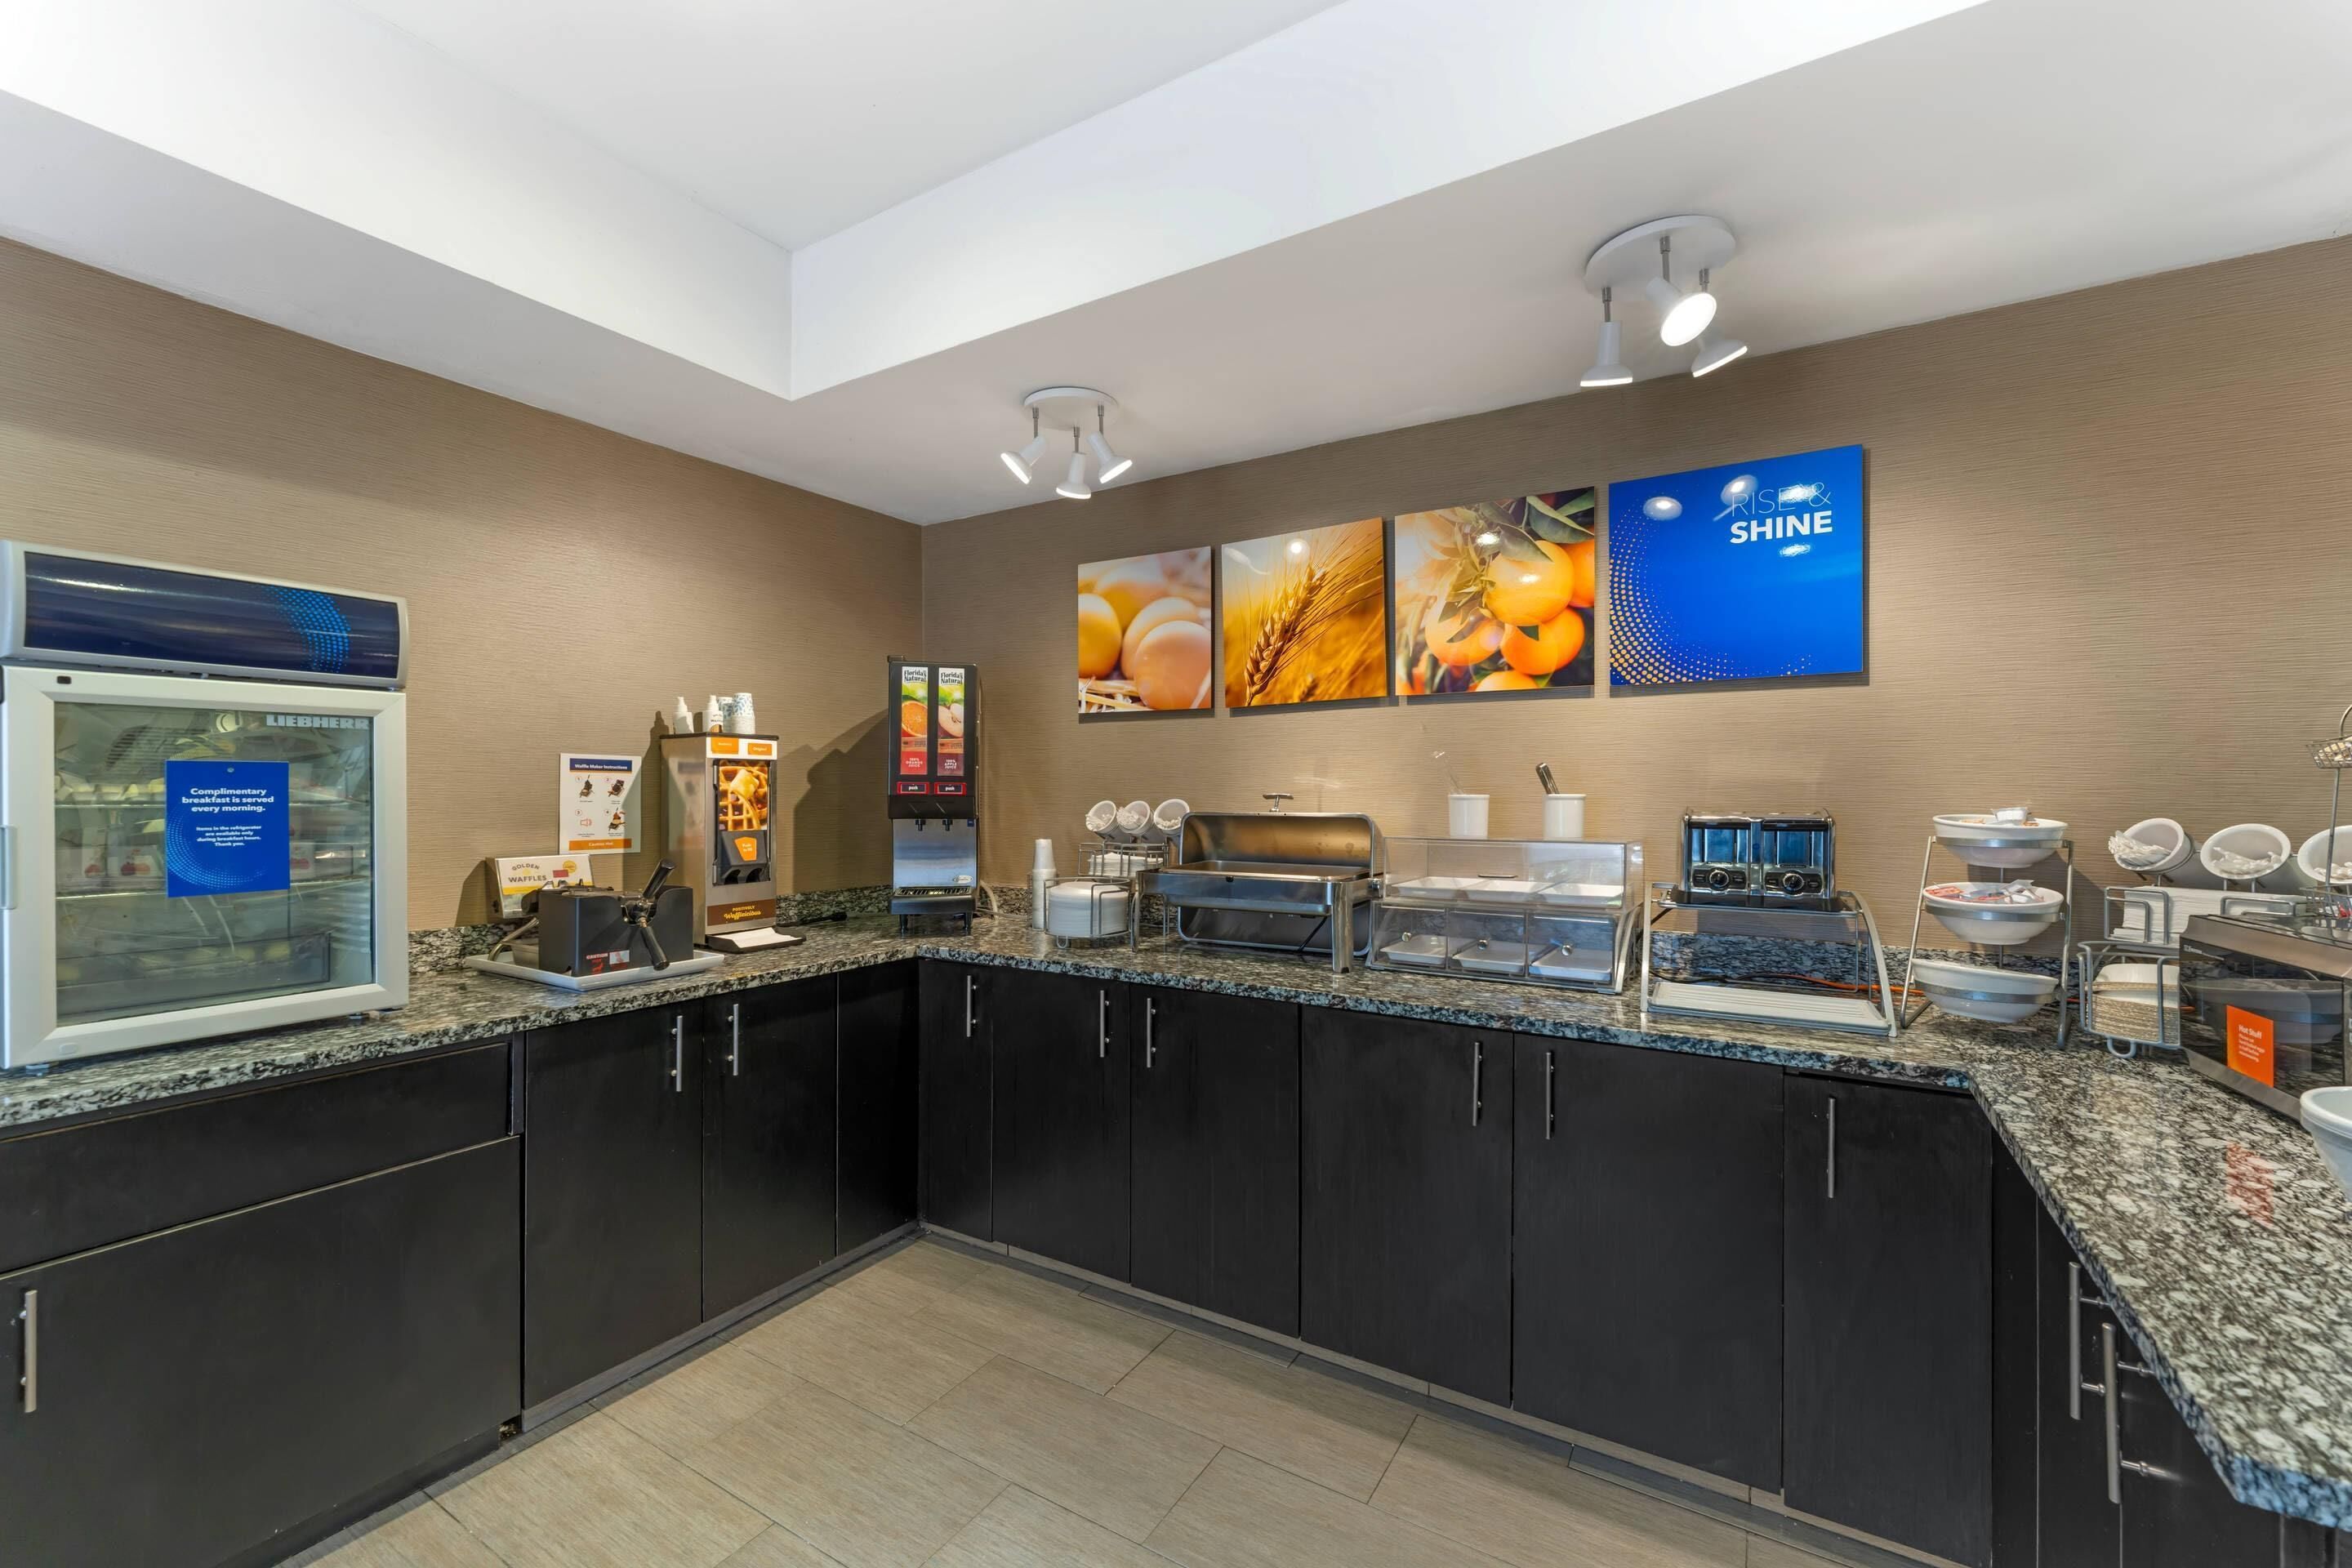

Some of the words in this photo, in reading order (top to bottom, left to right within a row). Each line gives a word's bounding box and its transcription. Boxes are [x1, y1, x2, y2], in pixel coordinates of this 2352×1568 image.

[1731, 488, 1797, 517] RISE
[1808, 482, 1832, 507] &
[1730, 510, 1833, 544] SHINE
[904, 670, 927, 678] Florida's
[266, 714, 369, 729] LIEBHERR
[190, 788, 267, 796] Complimentary
[222, 804, 266, 813] morning.
[511, 862, 541, 871] GOLDEN
[508, 875, 547, 883] WAFFLES
[2238, 1024, 2248, 1034] Hot
[2248, 1028, 2262, 1039] Stuff
